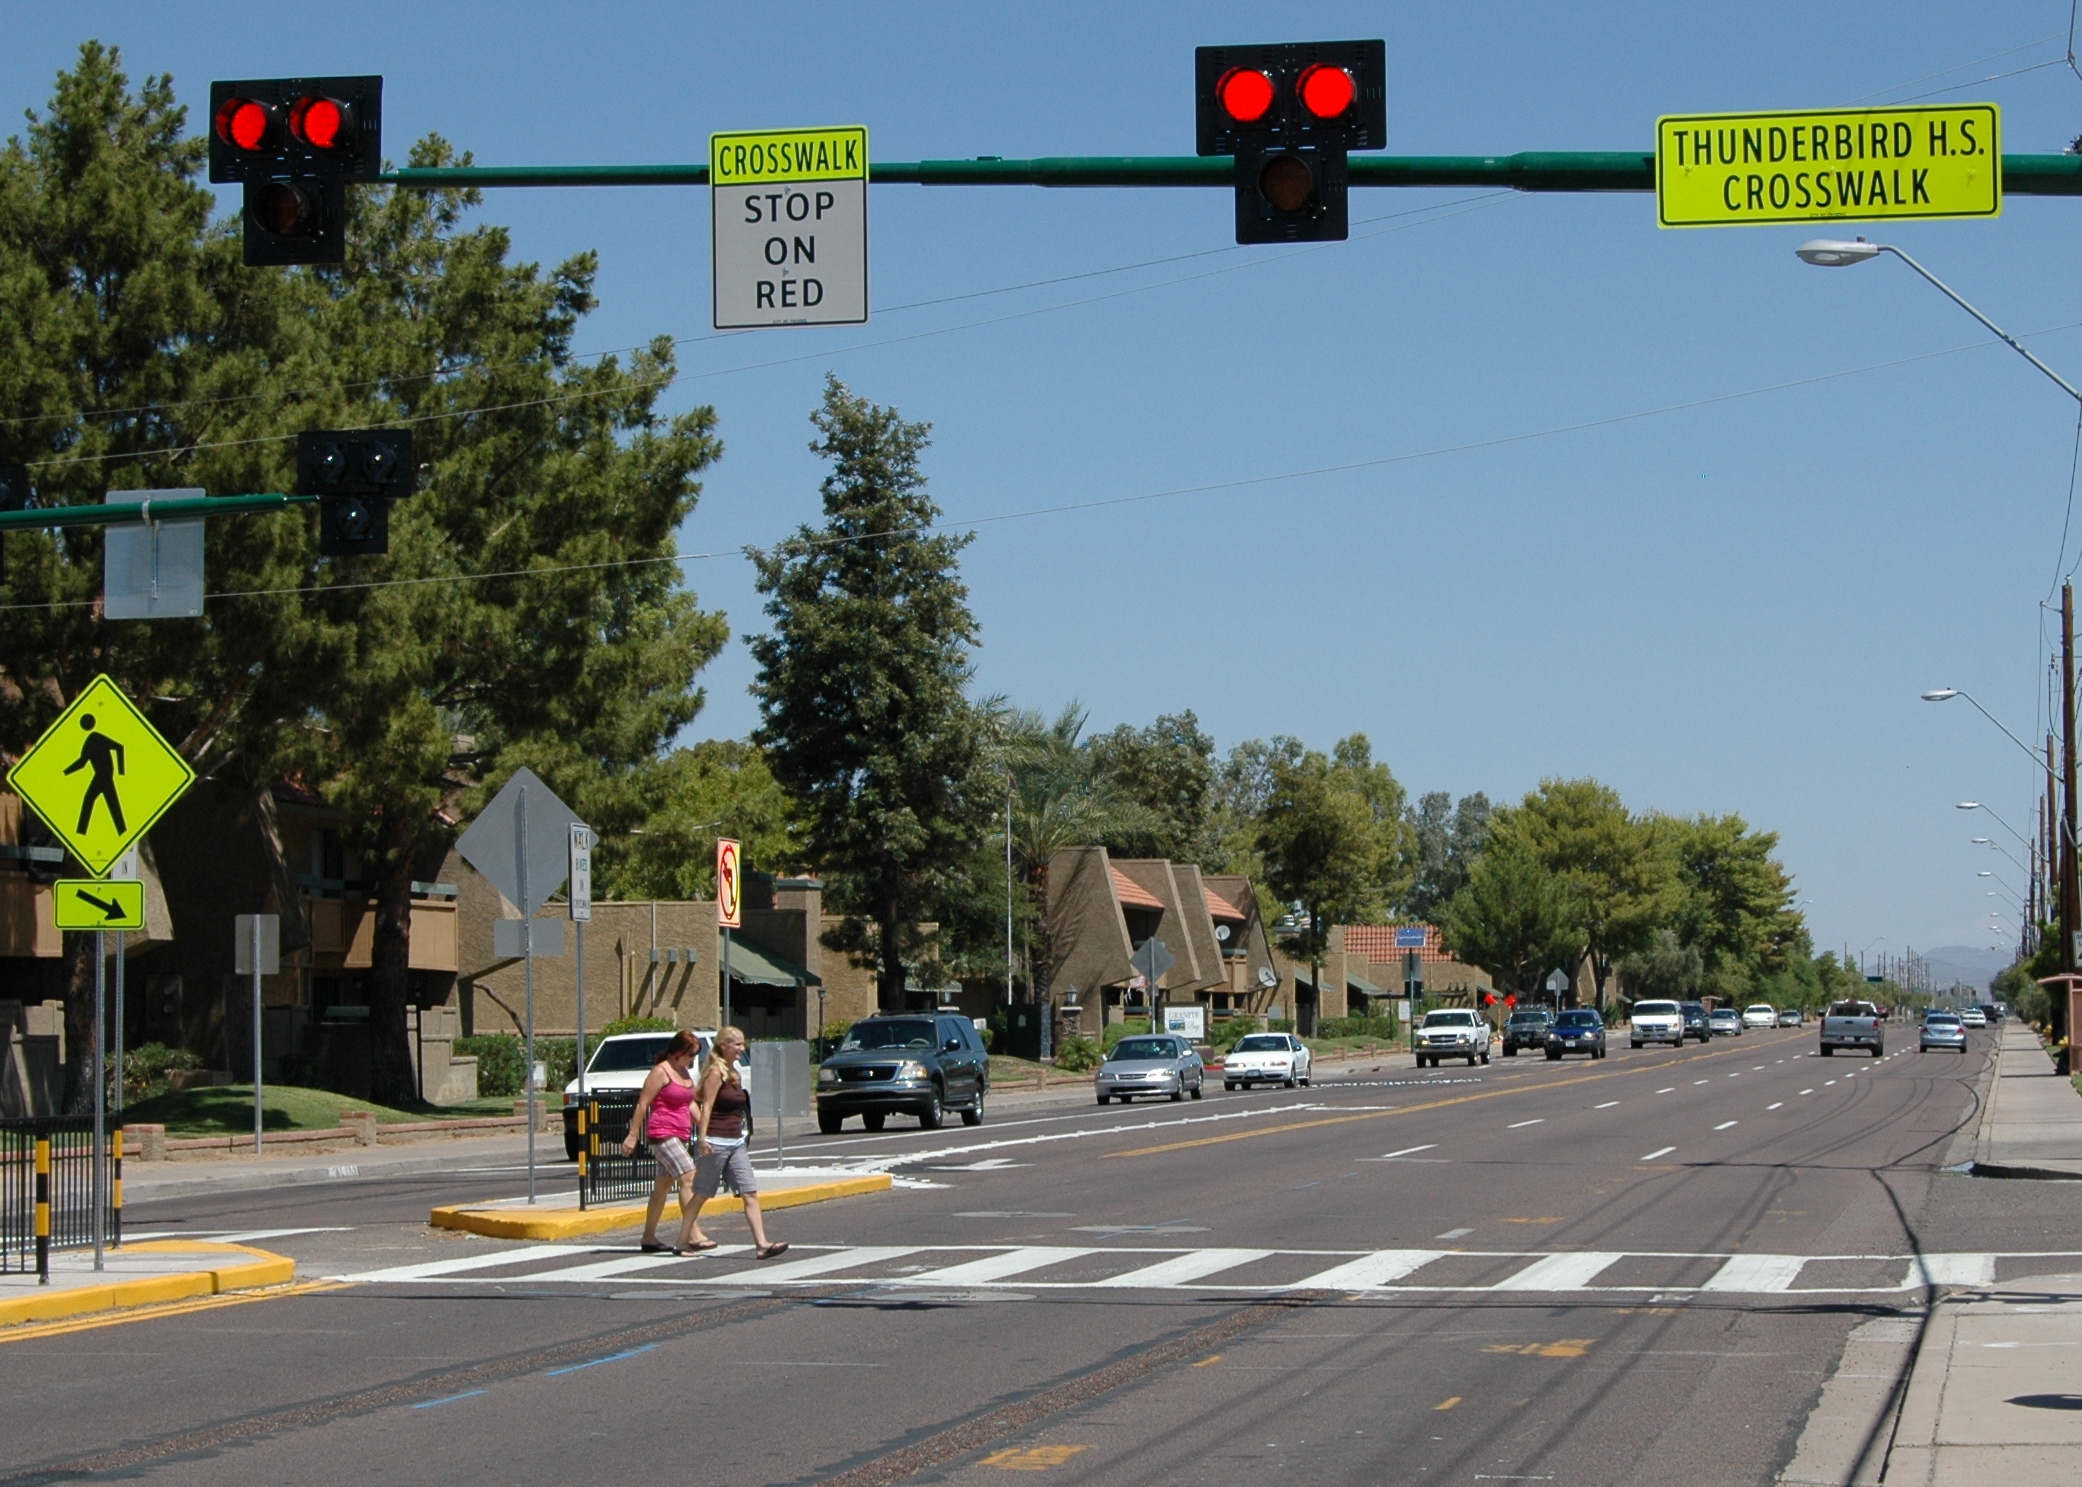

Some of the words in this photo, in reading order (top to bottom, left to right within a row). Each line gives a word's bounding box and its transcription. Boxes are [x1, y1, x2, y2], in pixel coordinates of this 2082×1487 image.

[720, 139, 858, 176] CROSSWALK
[1673, 121, 1913, 167] THUNDERBIRD
[1928, 119, 1985, 157] H.S.
[1723, 168, 1931, 211] CROSSWALK
[744, 191, 834, 223] STOP
[764, 235, 815, 265] ON
[756, 278, 824, 309] RED
